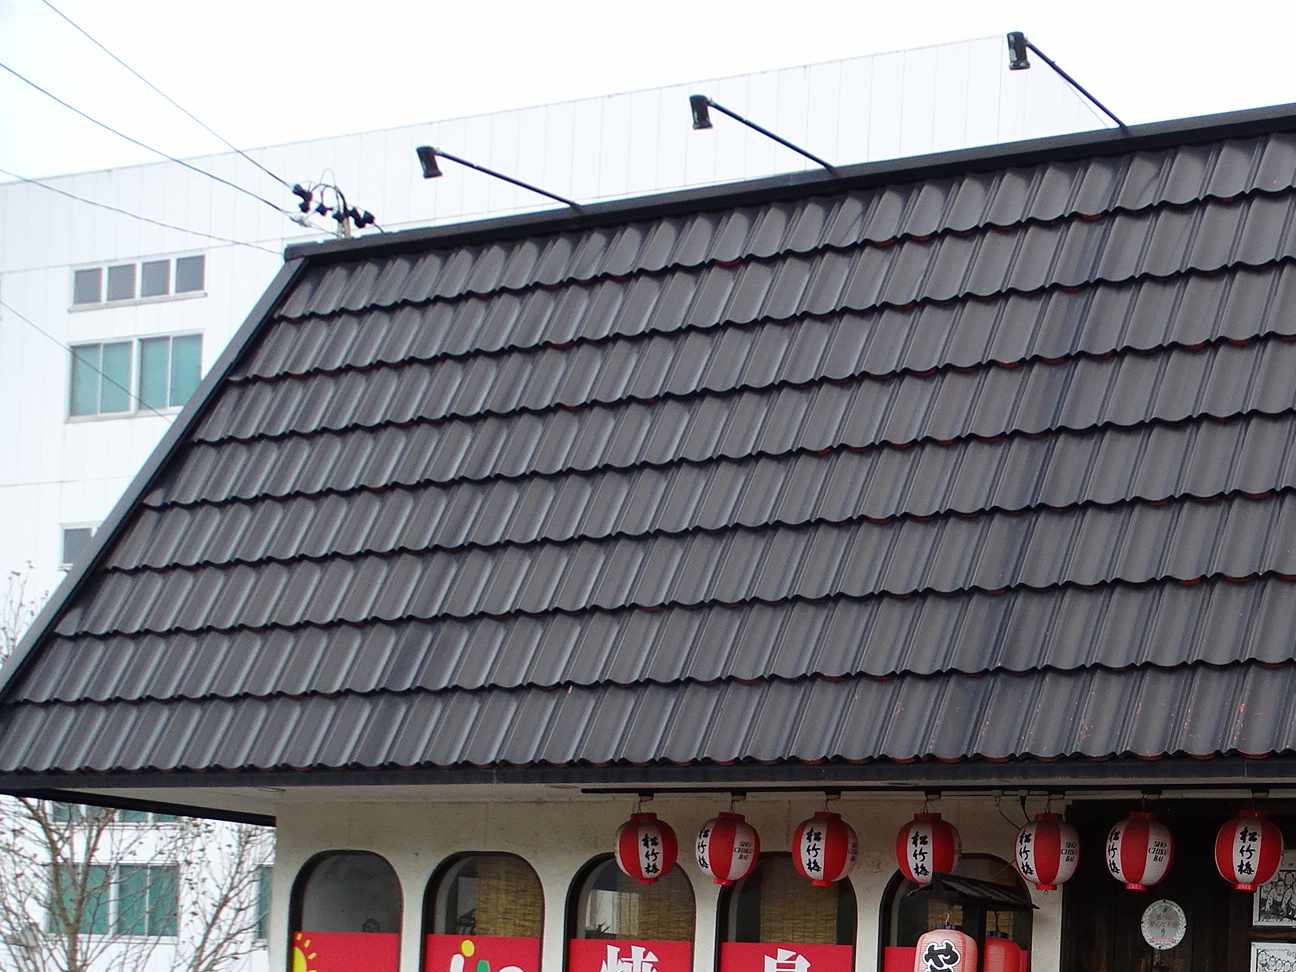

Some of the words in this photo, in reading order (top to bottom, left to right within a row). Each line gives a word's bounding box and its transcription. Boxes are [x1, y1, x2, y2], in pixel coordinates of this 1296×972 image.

[641, 833, 660, 874] 松竹梅
[806, 827, 822, 873] 松竹梅
[911, 831, 930, 877] 松竹梅
[1237, 827, 1258, 876] 松竹梅
